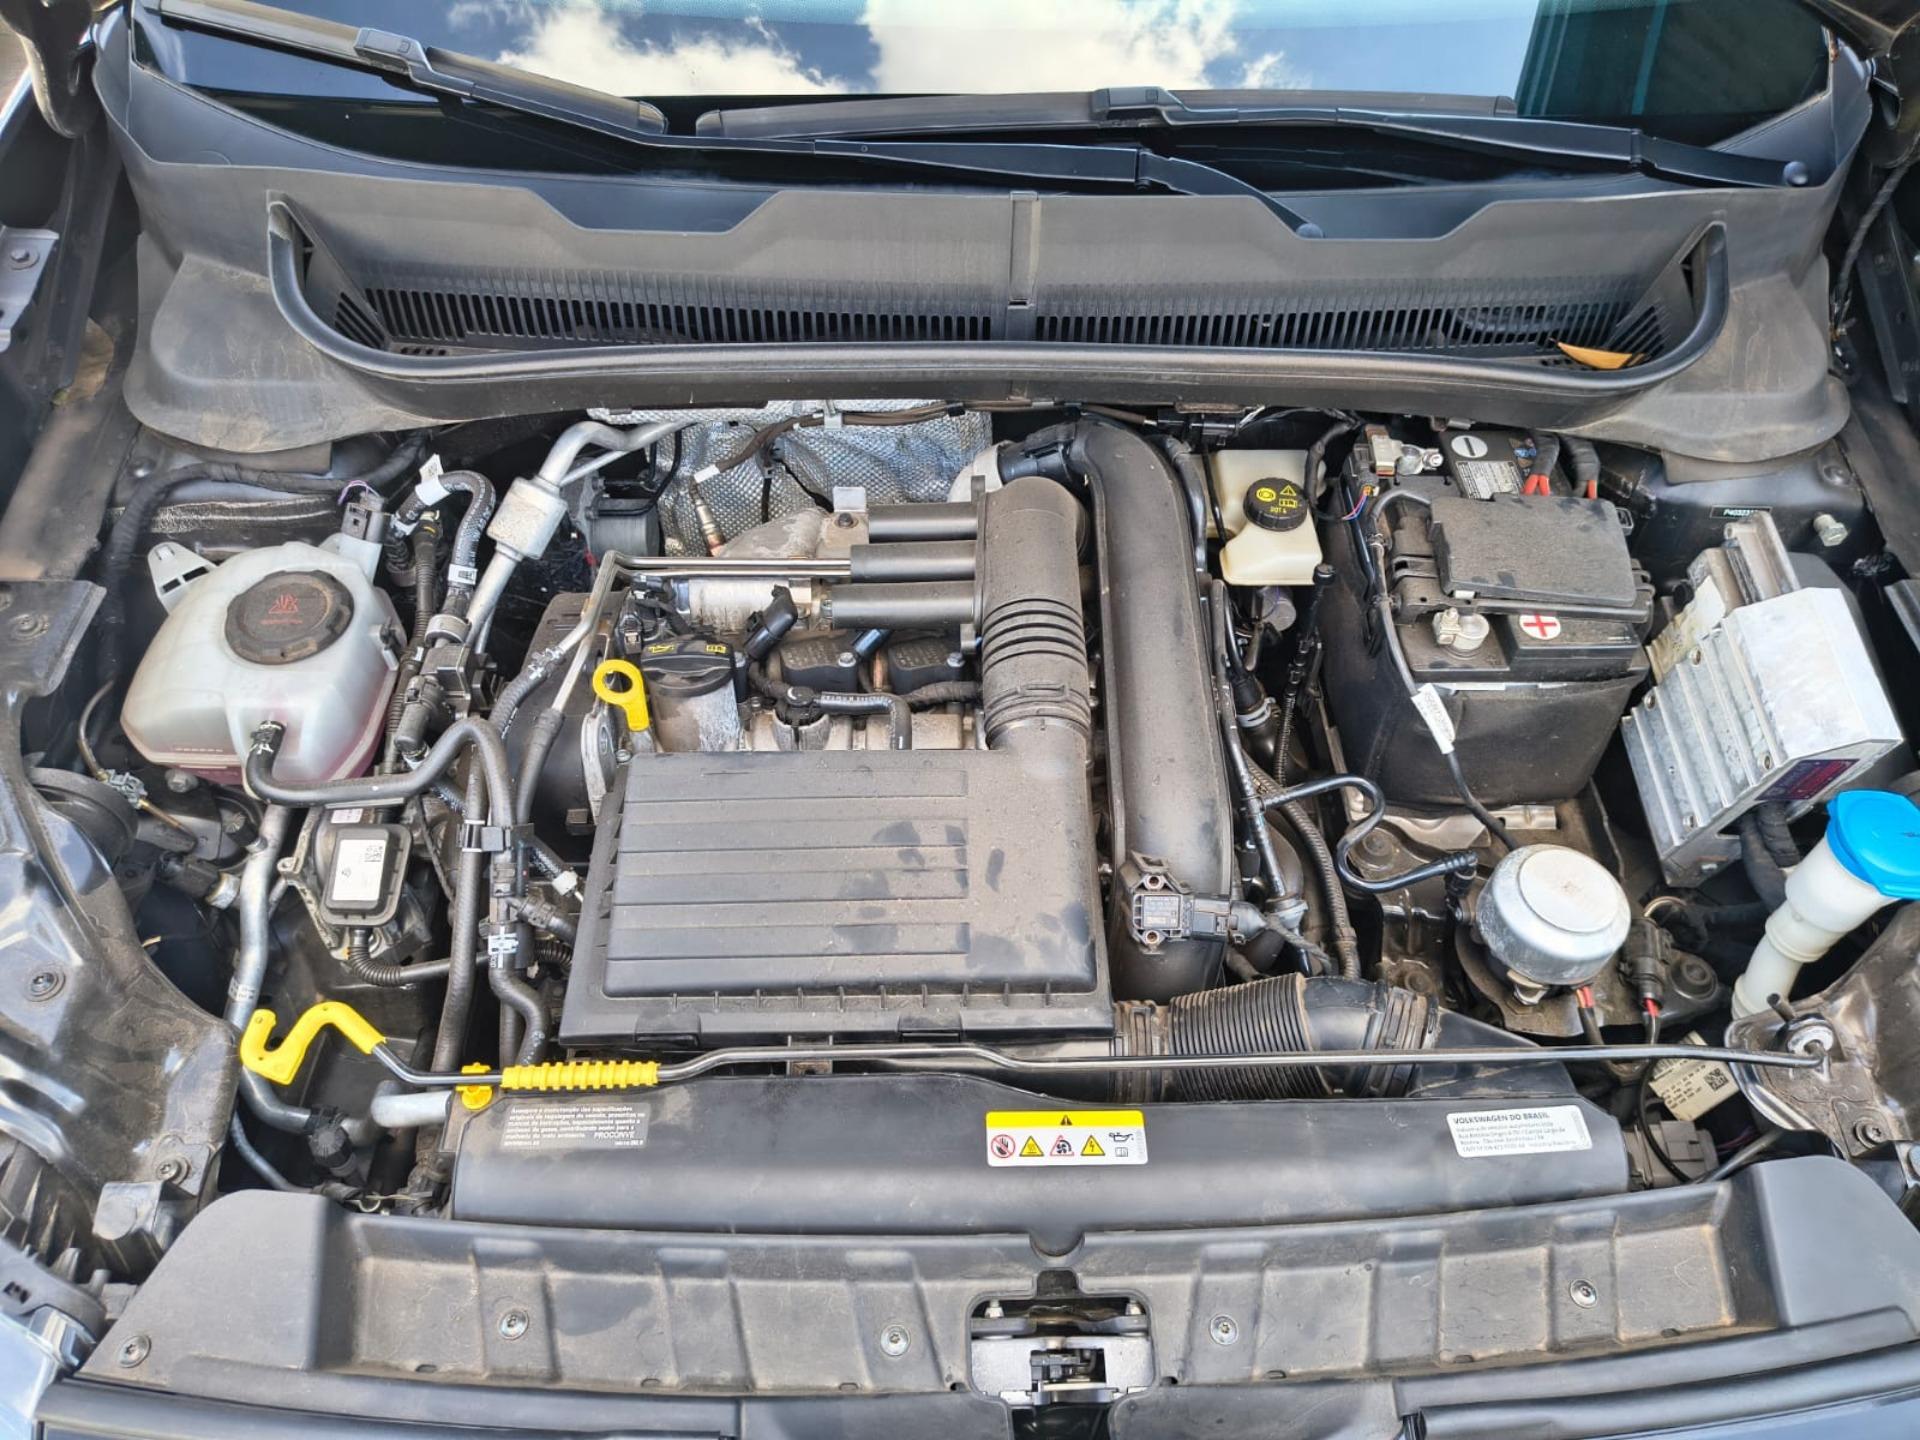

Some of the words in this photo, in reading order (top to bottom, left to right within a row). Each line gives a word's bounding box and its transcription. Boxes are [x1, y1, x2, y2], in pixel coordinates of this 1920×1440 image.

[1453, 1115, 1508, 1124] VOLKSWAGEN
[1523, 1112, 1550, 1120] BRASIL
[593, 1131, 635, 1140] PROCONVE
